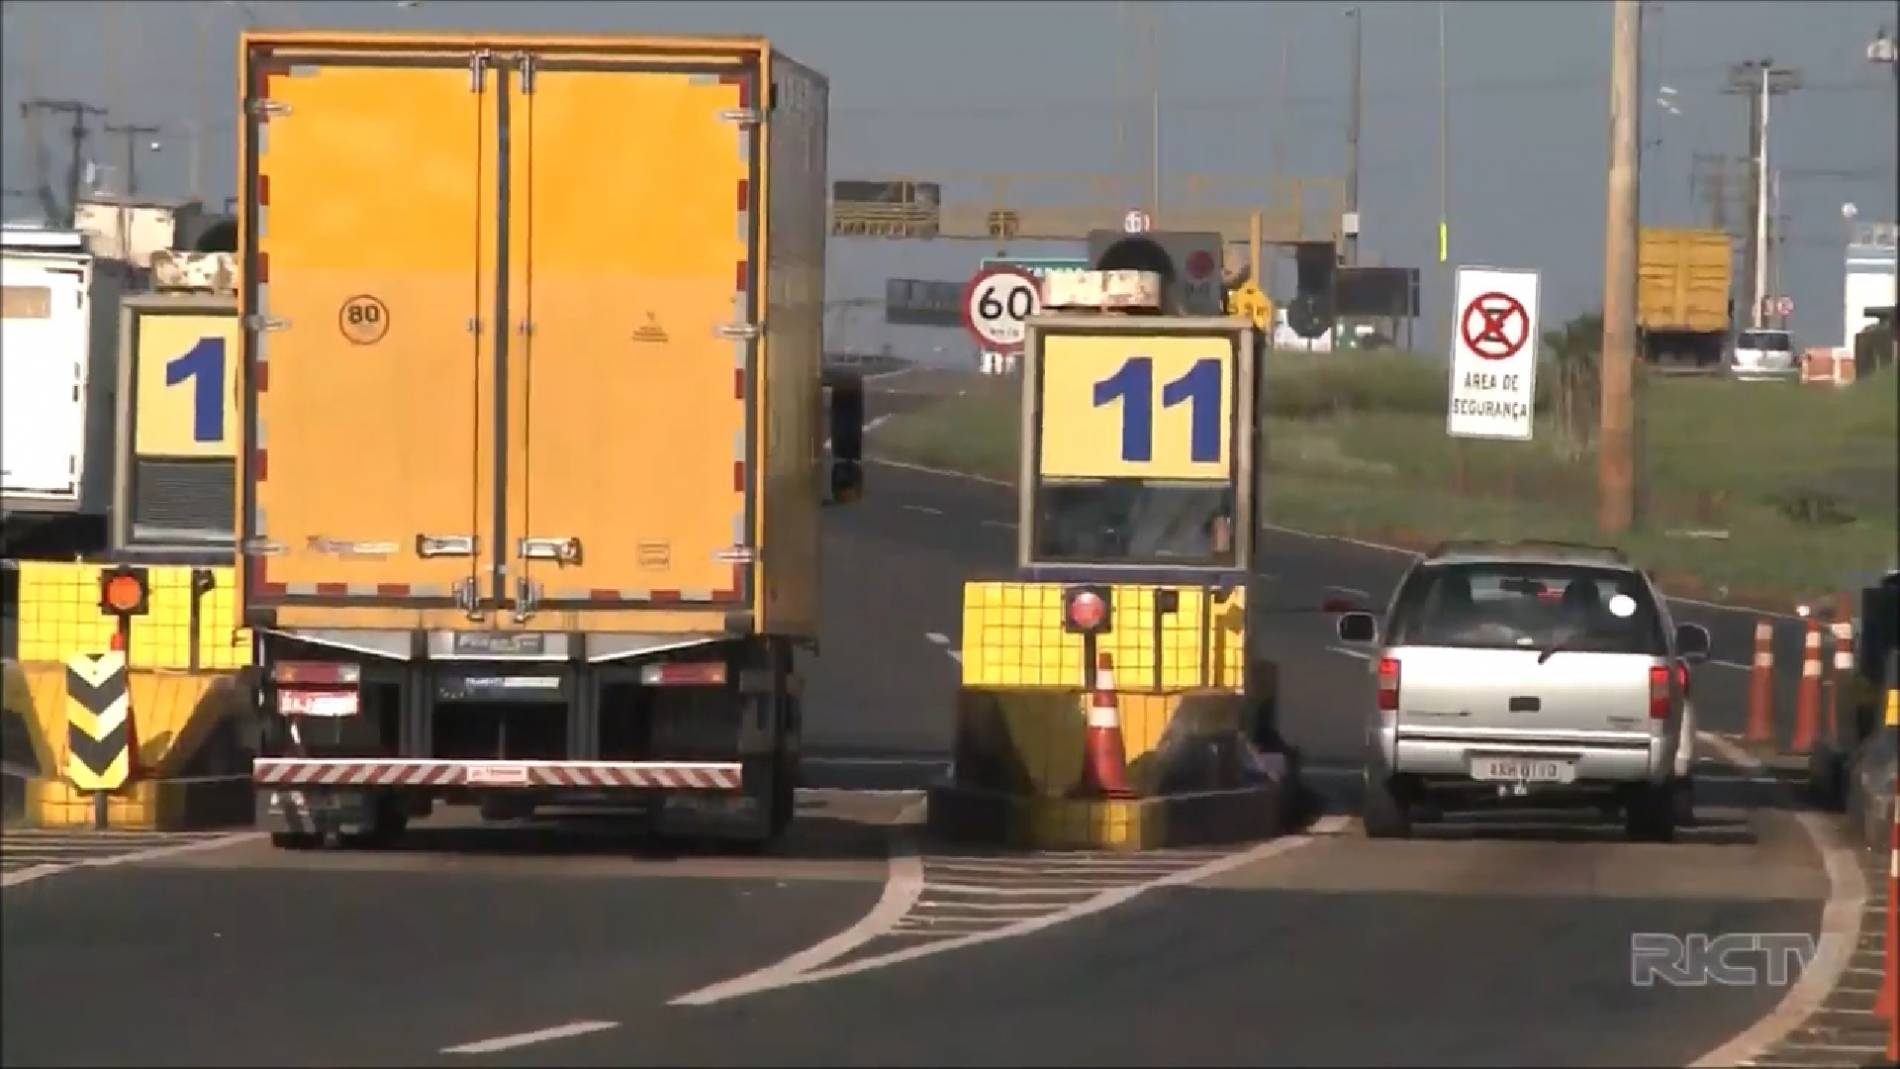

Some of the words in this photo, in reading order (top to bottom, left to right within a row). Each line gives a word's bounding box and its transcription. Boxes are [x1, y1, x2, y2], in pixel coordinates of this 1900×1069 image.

[347, 304, 380, 325] 80
[978, 285, 1034, 320] 60
[1502, 373, 1519, 392] DE
[1093, 356, 1222, 464] 11
[1453, 397, 1527, 423] SEGURANÇA
